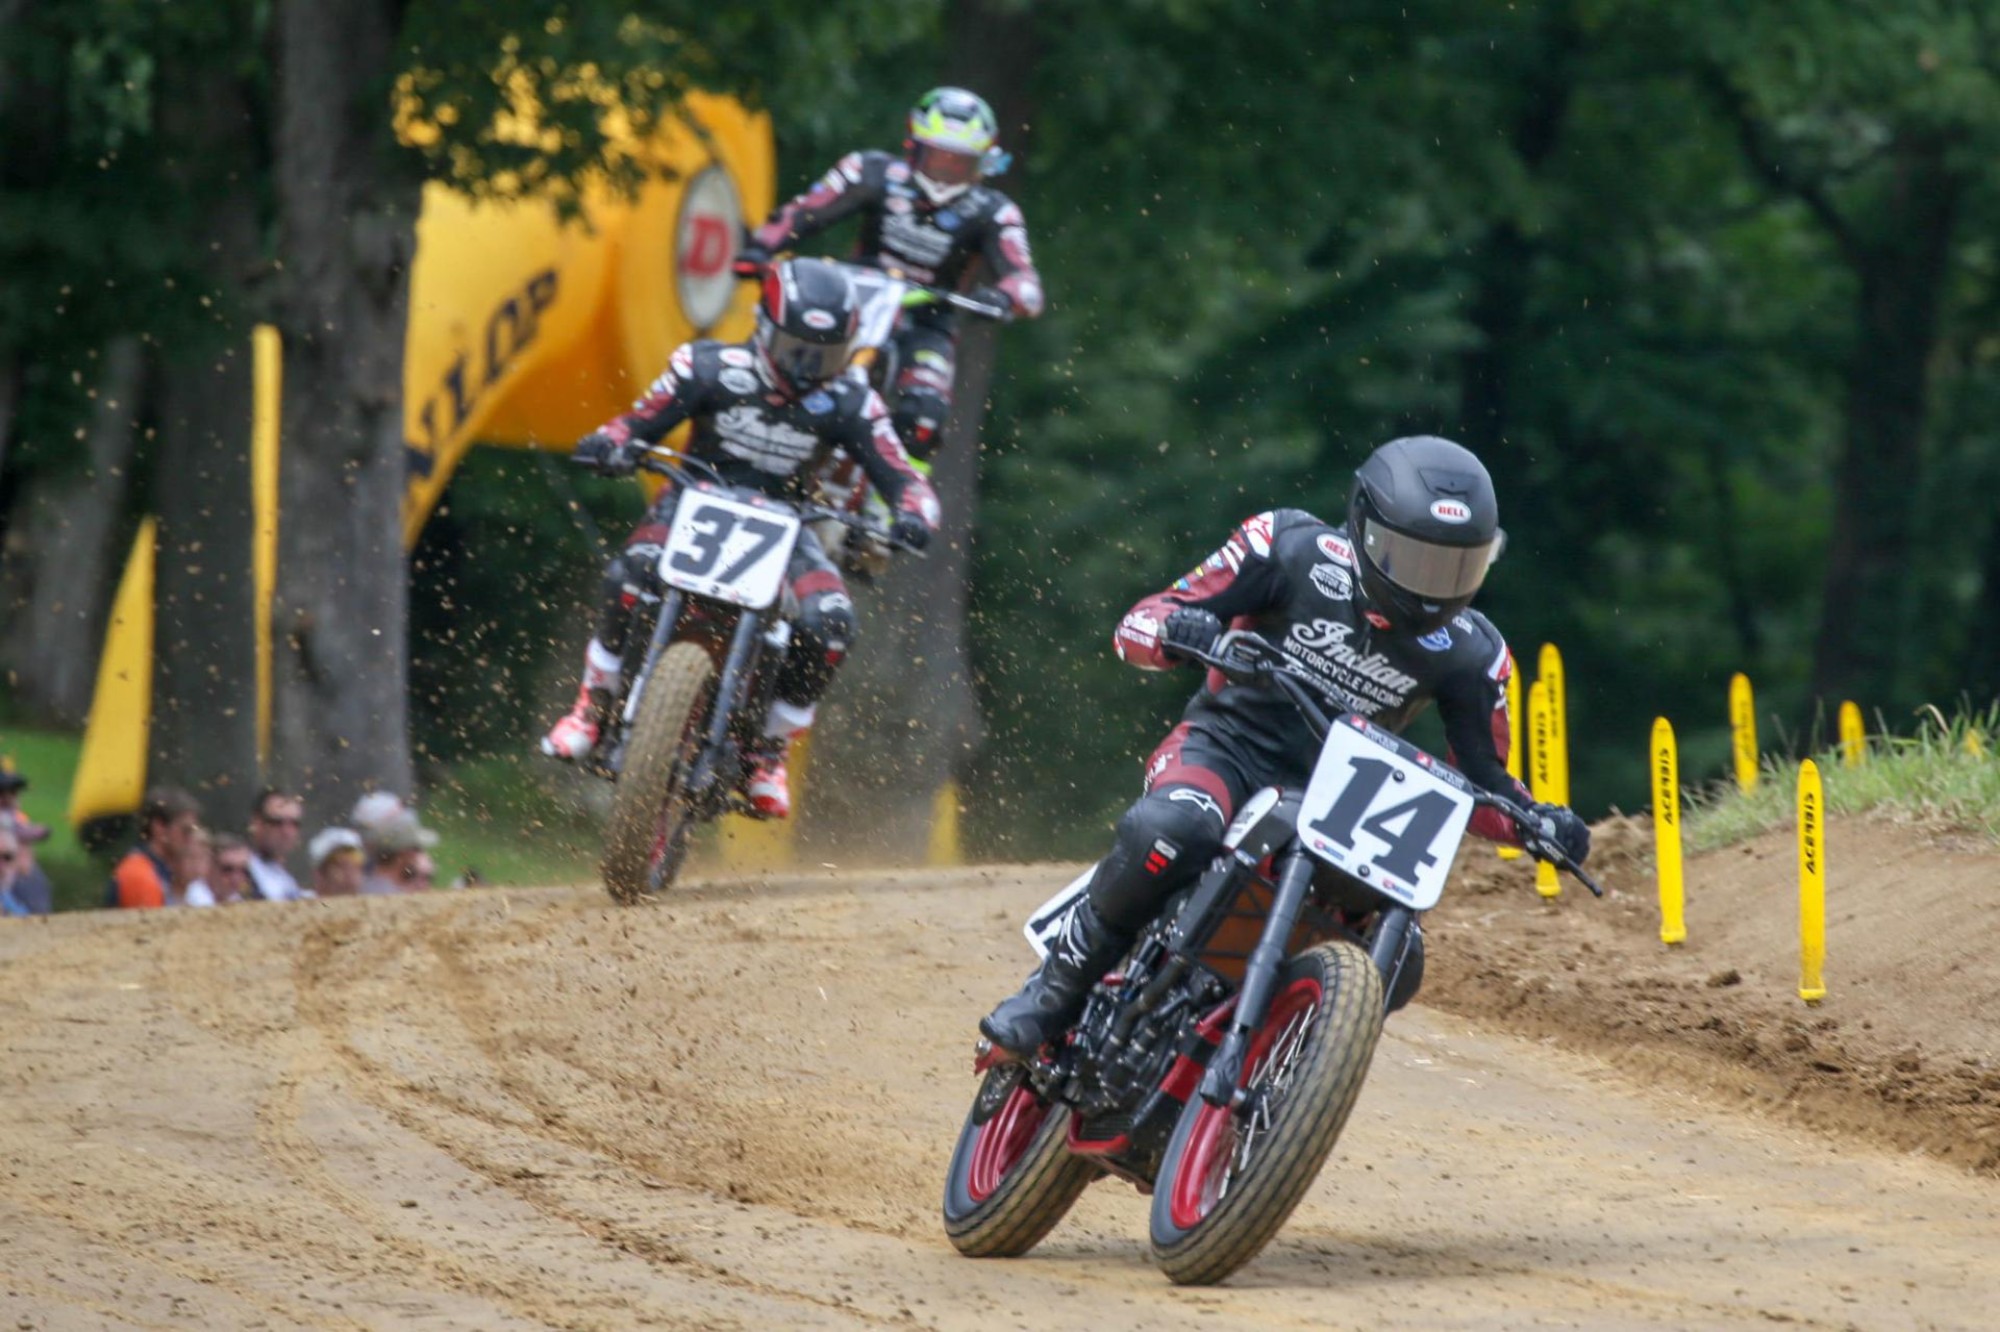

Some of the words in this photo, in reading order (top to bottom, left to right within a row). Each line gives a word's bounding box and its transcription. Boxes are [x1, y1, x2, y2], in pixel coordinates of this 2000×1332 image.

[683, 213, 731, 278] D
[670, 504, 788, 585] 37
[1438, 505, 1465, 517] BELL
[1282, 635, 1364, 692] MOTORCYCLE
[1361, 679, 1405, 708] RACING
[1292, 617, 1418, 695] Indian
[1537, 711, 1549, 785] ACERBIS
[1661, 747, 1675, 827] ACERBIS
[1308, 755, 1459, 888] 14
[1803, 791, 1817, 876] ACERBIS
